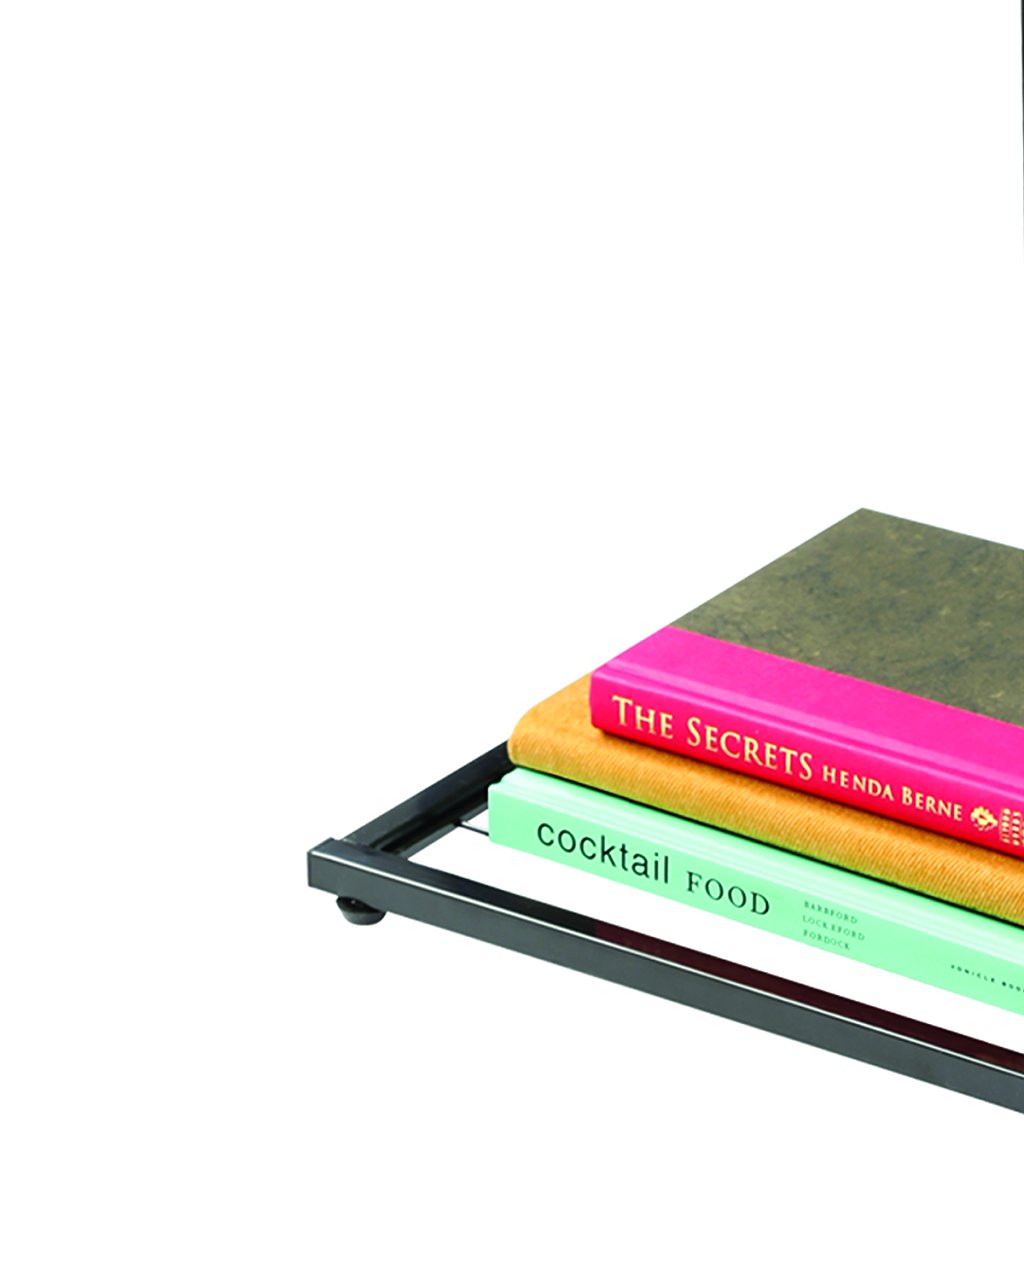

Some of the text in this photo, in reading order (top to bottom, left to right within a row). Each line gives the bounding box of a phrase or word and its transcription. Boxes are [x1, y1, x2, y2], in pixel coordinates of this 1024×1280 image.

[612, 695, 962, 821] THE SECRETS HENDA BERNE
[537, 822, 770, 916] cocktail FOOD
